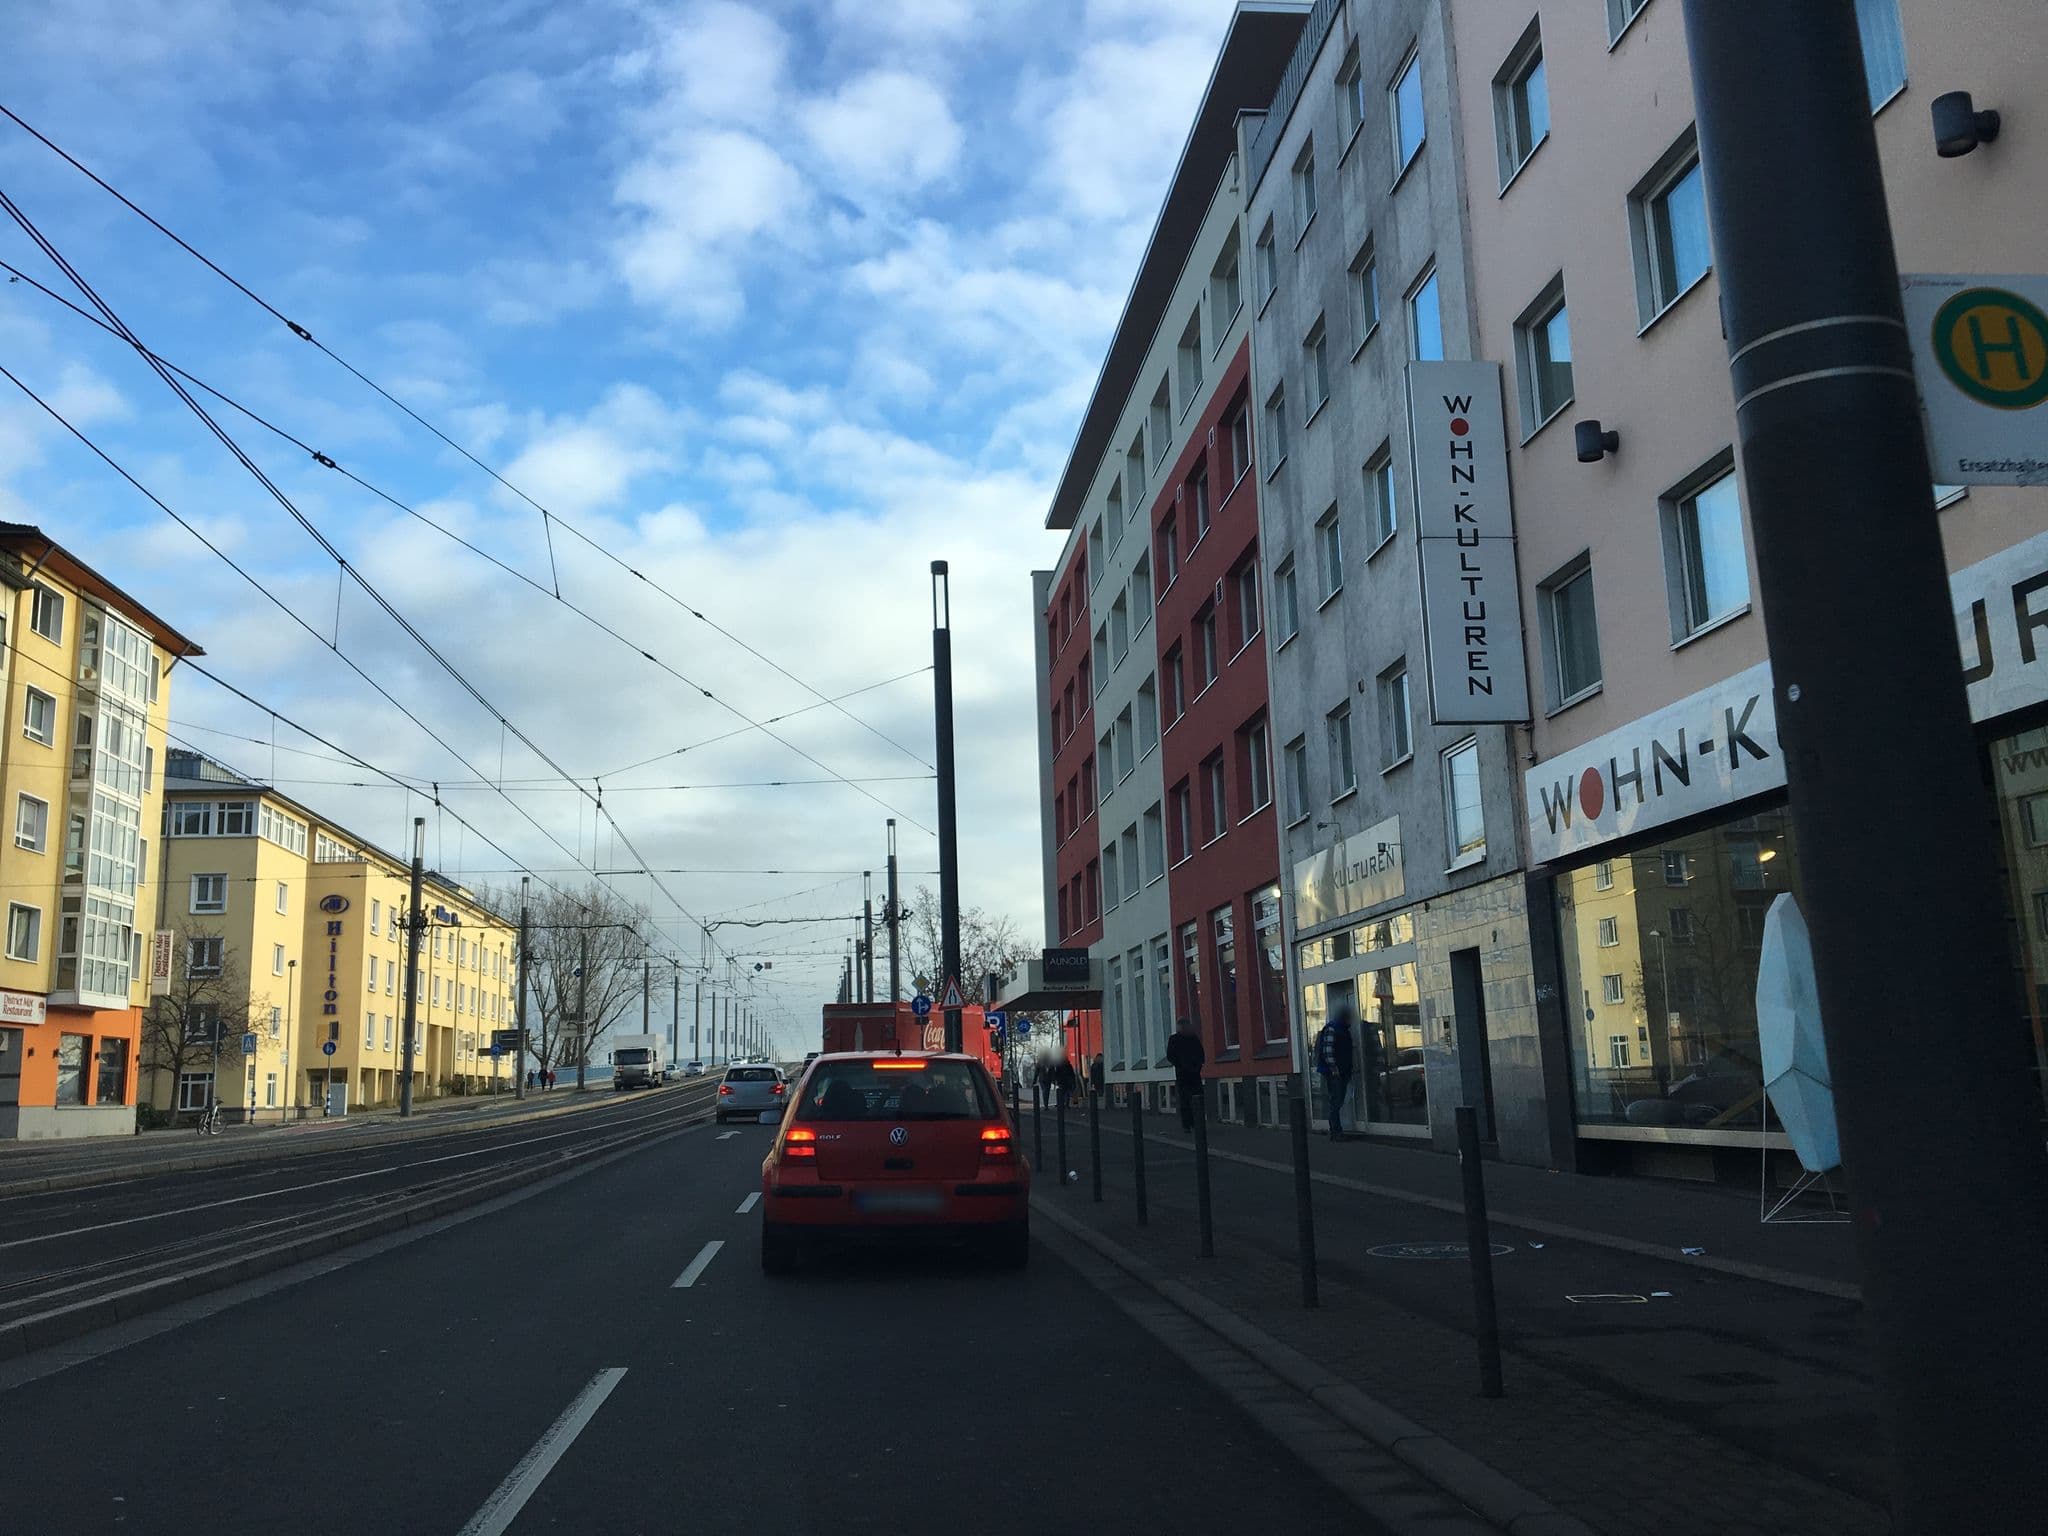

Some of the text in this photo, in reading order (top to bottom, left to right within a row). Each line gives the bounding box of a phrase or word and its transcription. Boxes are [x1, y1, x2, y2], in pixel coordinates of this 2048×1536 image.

[161, 935, 170, 977] Restaurant
[323, 920, 343, 1016] Hilton
[3, 1004, 33, 1017] Restaurant
